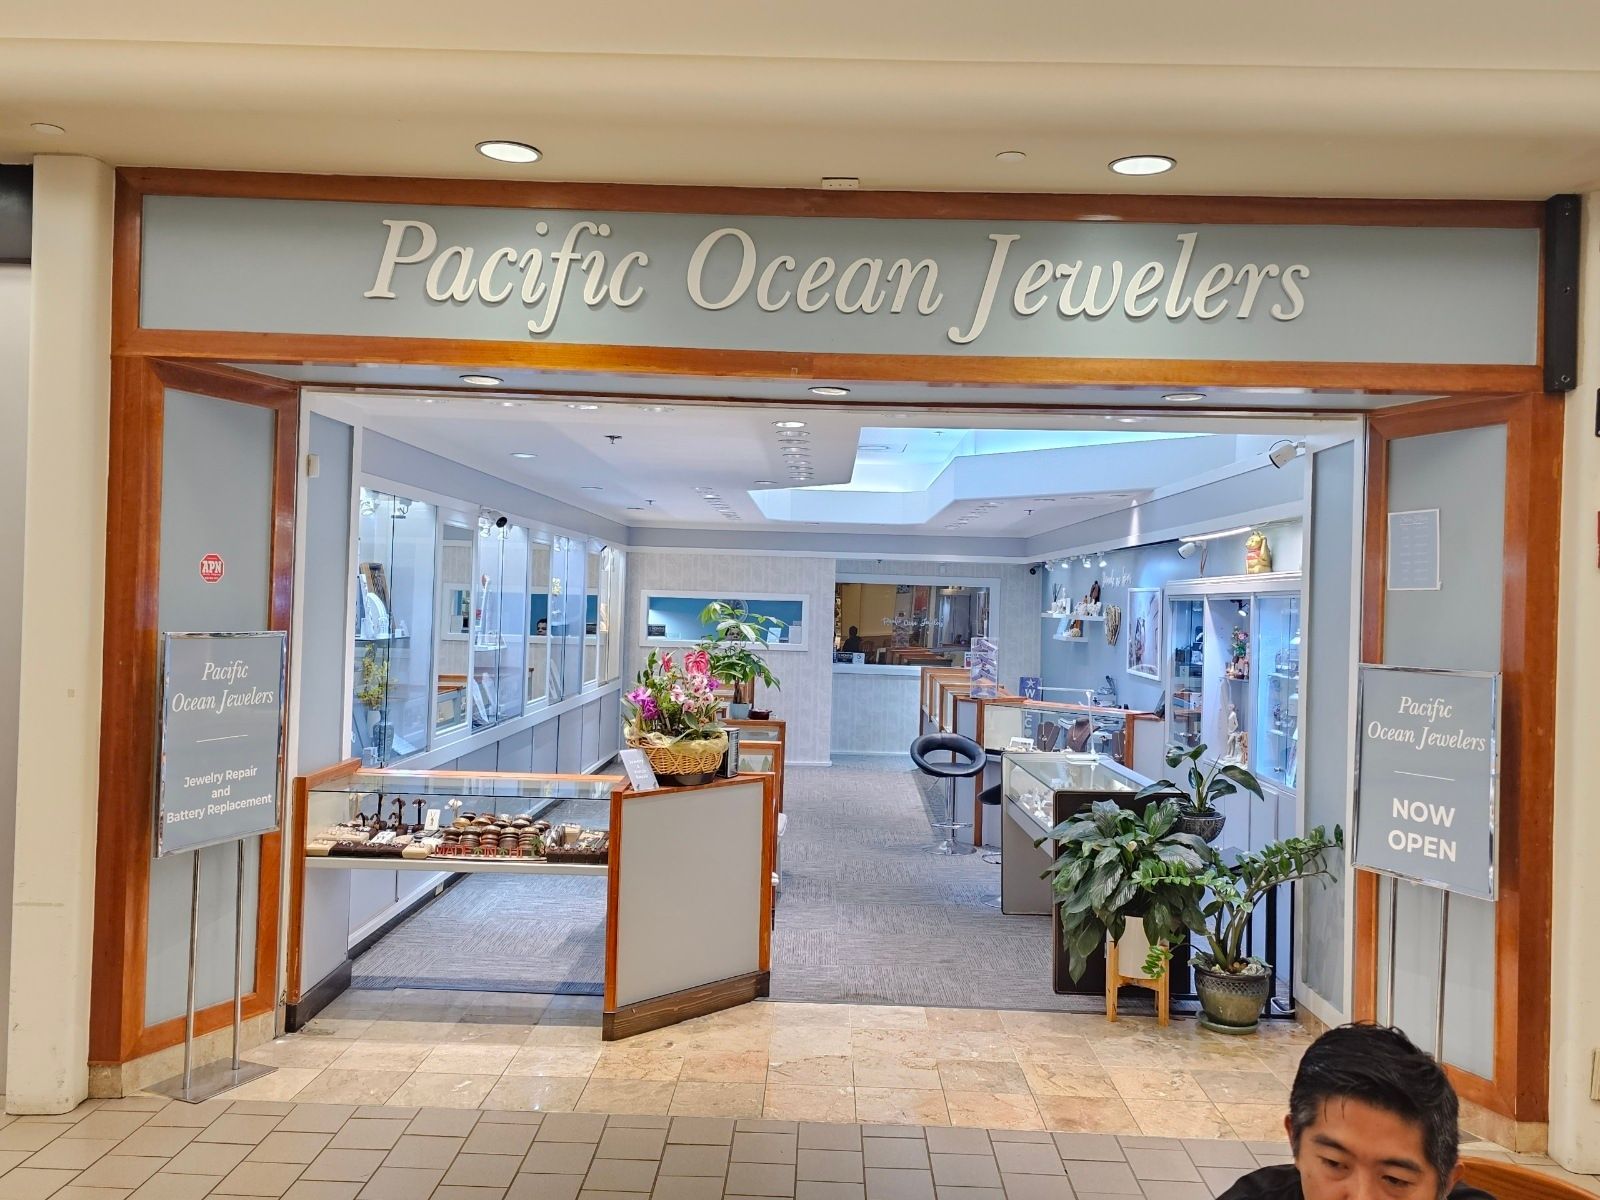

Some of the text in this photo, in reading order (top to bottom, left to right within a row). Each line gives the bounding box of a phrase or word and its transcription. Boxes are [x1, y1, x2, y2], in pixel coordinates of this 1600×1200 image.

[363, 218, 1311, 344] Pacific Ocean Jewelers
[202, 560, 222, 573] APN
[202, 660, 249, 685] Pacific
[171, 686, 274, 714] Ocean Jewelers
[1398, 696, 1453, 723] Pacific
[1367, 720, 1487, 751] Ocean Jewelers
[183, 765, 258, 788] Jewelry Repair
[211, 785, 231, 799] and
[166, 793, 273, 824] Battery Replacement
[1392, 798, 1456, 828] NOW
[1388, 829, 1457, 862] OPEN
